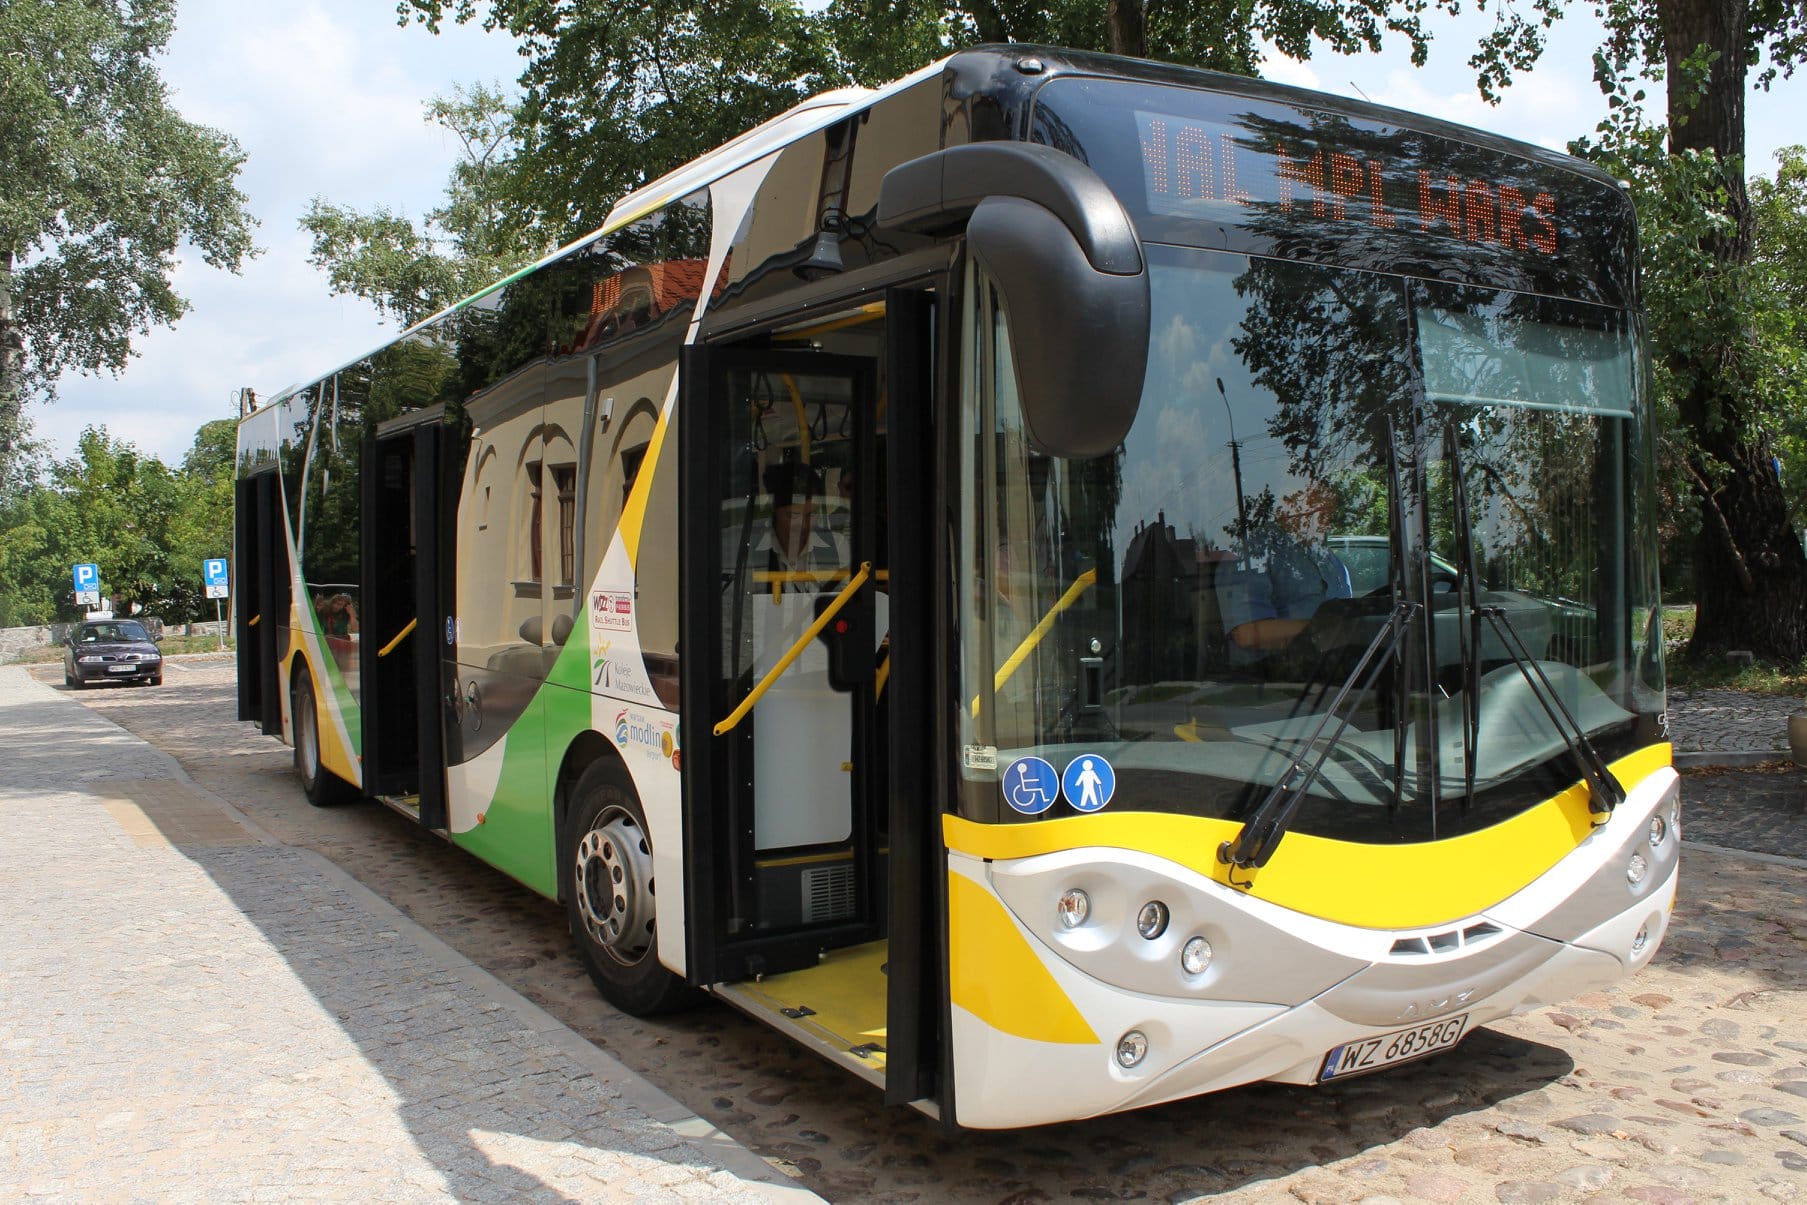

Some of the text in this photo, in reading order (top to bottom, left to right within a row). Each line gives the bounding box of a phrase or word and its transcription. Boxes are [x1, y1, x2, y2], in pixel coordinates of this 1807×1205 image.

[1276, 142, 1395, 228] MPL
[1418, 168, 1557, 254] WARS
[79, 567, 92, 583] P
[209, 561, 222, 578] P
[630, 723, 661, 748] modlin
[1341, 1020, 1459, 1070] WZ 6858G
